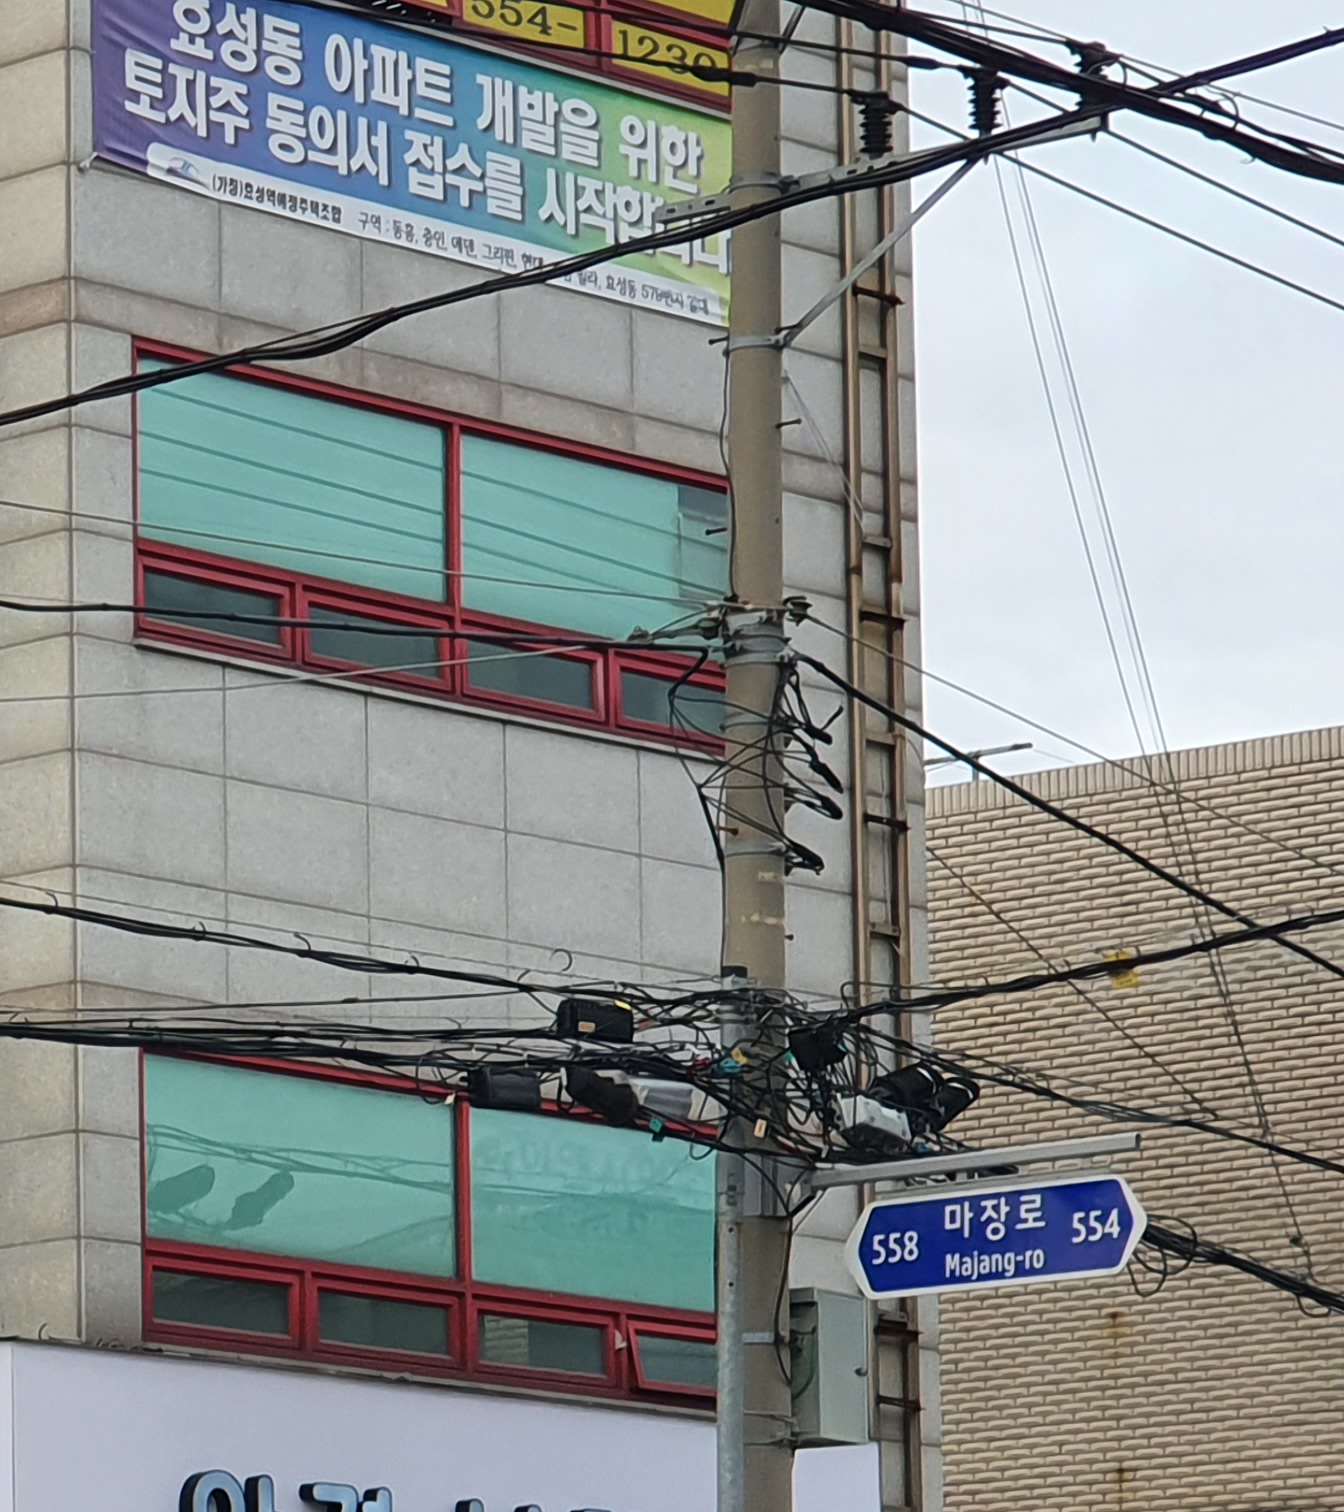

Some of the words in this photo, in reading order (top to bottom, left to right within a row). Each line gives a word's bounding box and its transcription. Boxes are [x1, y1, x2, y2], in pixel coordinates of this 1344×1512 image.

[123, 47, 250, 146] 토지주
[265, 91, 389, 187] 동의서
[403, 128, 524, 222] 접수를
[324, 32, 454, 127] 아파트
[475, 73, 601, 168] 개발을
[618, 114, 706, 194] 위한
[943, 1193, 1047, 1242] 마장로
[1071, 1207, 1122, 1244] 554
[871, 1230, 919, 1265] 558
[945, 1249, 1045, 1281] Majang-ro
